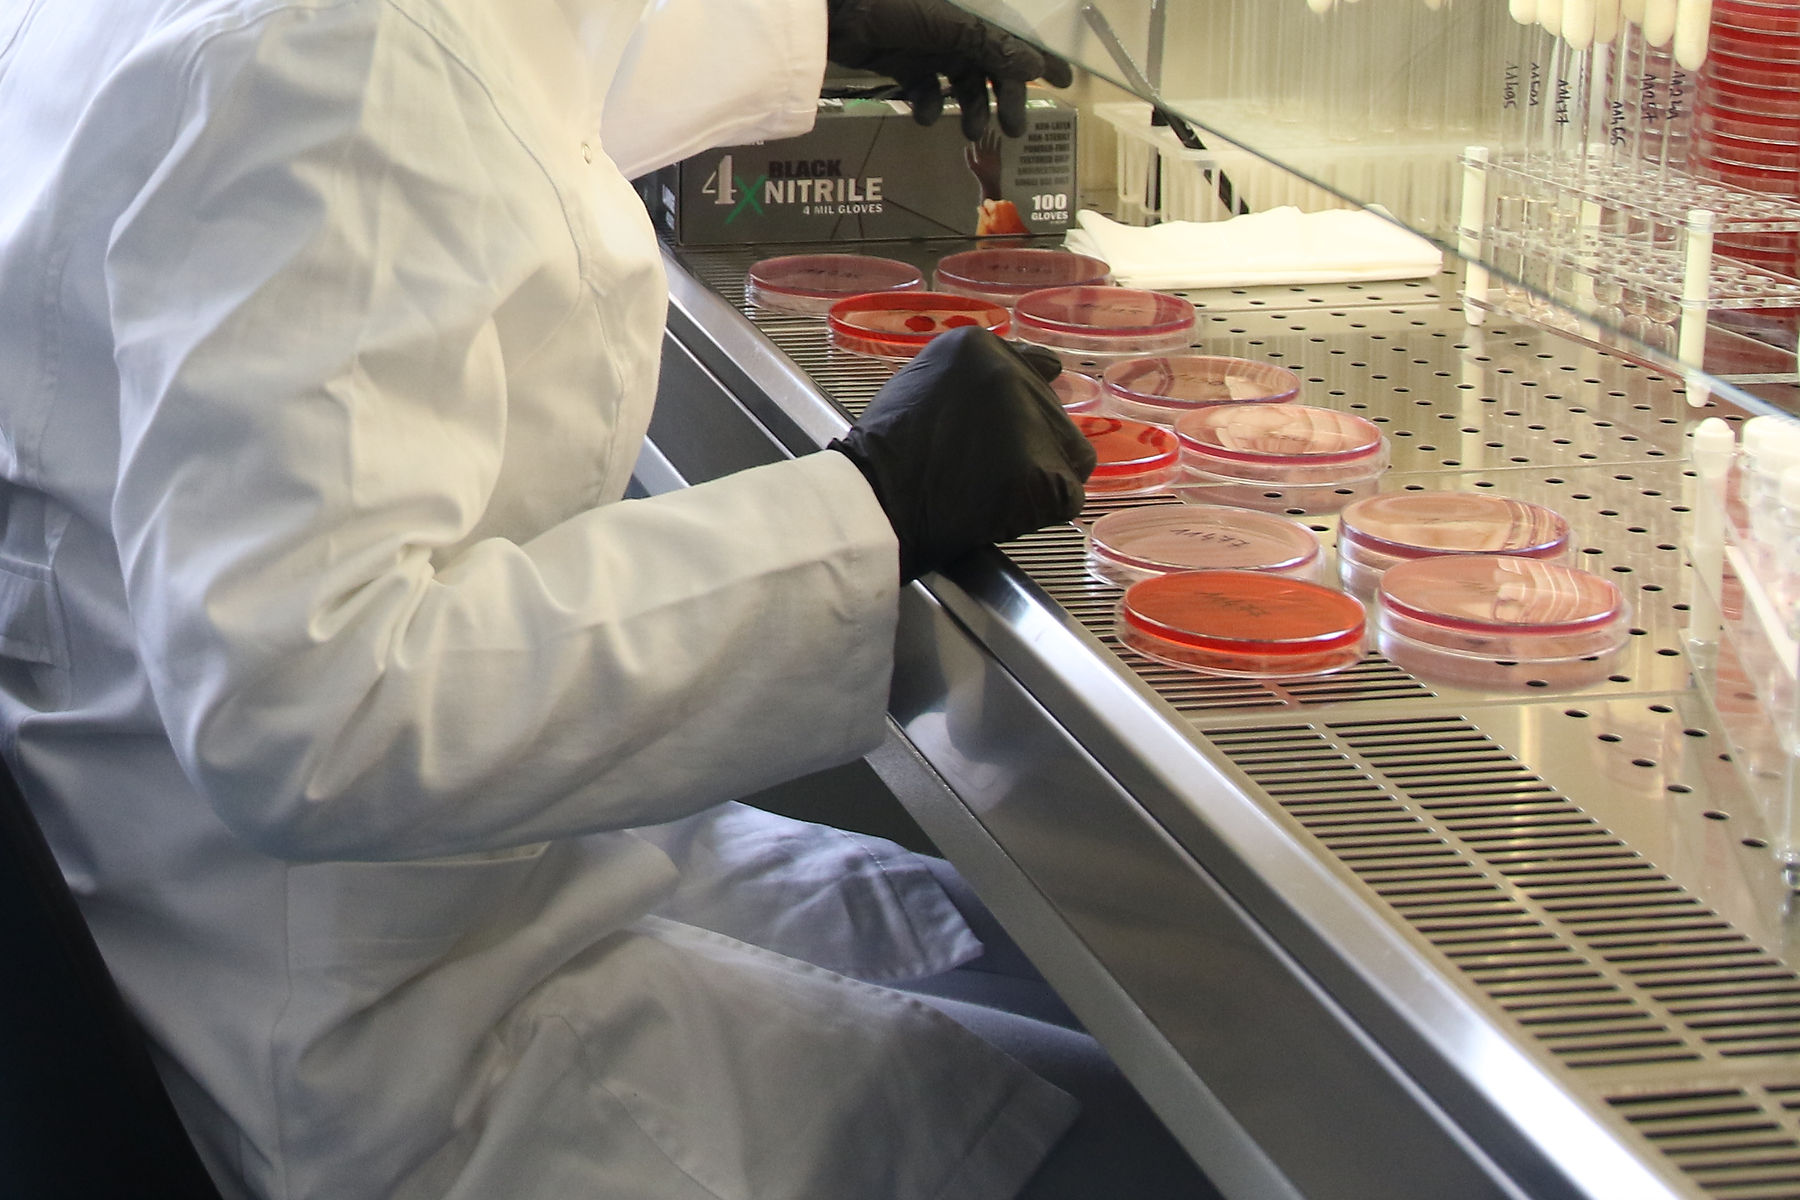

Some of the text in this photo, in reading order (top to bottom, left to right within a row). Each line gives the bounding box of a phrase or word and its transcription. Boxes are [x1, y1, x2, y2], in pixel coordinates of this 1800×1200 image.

[768, 159, 843, 179] BLACK
[765, 176, 884, 205] NITRILE
[802, 203, 884, 215] 4 MIL GLOVES
[1031, 193, 1068, 210] 100
[1030, 210, 1069, 221] GLOVES
